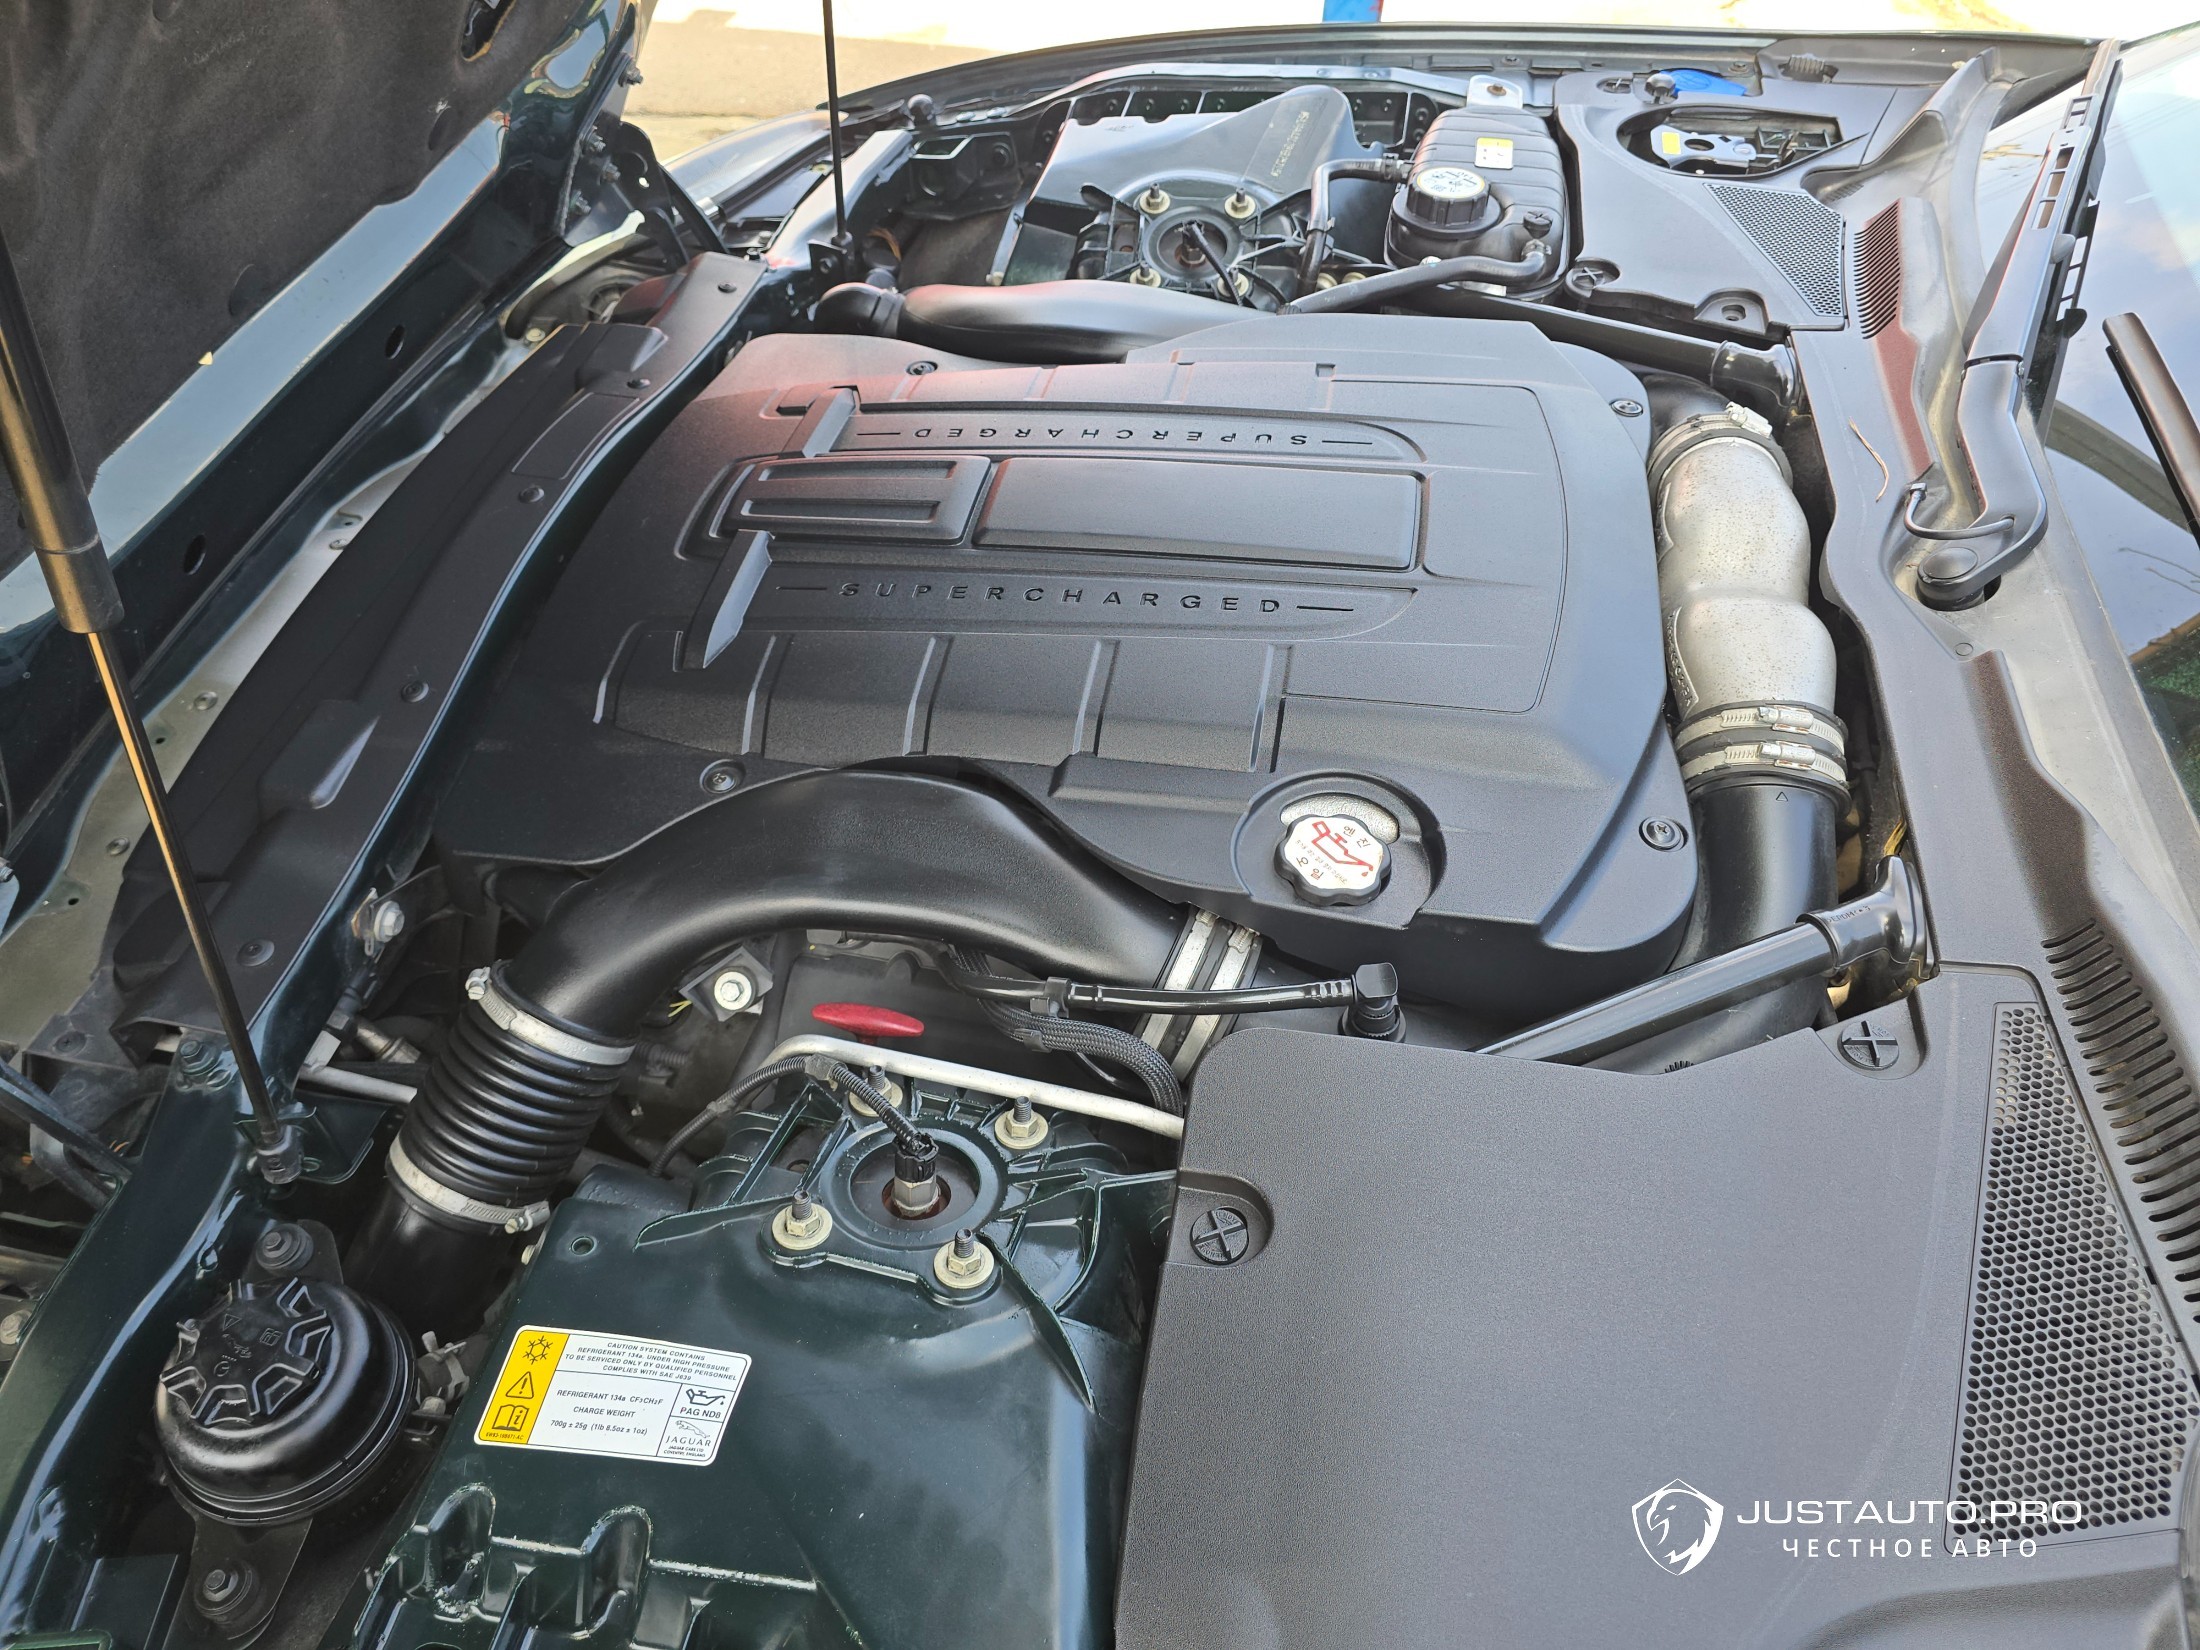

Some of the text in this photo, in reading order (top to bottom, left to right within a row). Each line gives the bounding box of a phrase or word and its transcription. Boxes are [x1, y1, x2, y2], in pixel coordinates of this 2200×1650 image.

[915, 427, 1308, 447] SUPERCHARGED
[838, 581, 1280, 613] SUPERCHARGED
[577, 1347, 626, 1356] REFRIGERANT
[647, 1354, 670, 1362] UNDER
[692, 1361, 730, 1372] PRESSURE
[607, 1342, 705, 1360] CAUTION SYSTEM CONTAINS
[586, 1355, 621, 1364] SERVICED
[655, 1363, 692, 1373] QUALIFIED
[694, 1367, 737, 1380] PERSONNEL
[602, 1365, 638, 1373] COMPLIES
[557, 1389, 609, 1400] REFRIGERANT
[610, 1394, 626, 1402] 134a
[573, 1406, 636, 1418] CHARGE WEIGHT
[680, 1406, 721, 1419] PAG ND8
[550, 1419, 567, 1429] 700g
[574, 1421, 587, 1430] 25g
[633, 1427, 648, 1436] 1oz)
[665, 1435, 711, 1447] JAGUAR
